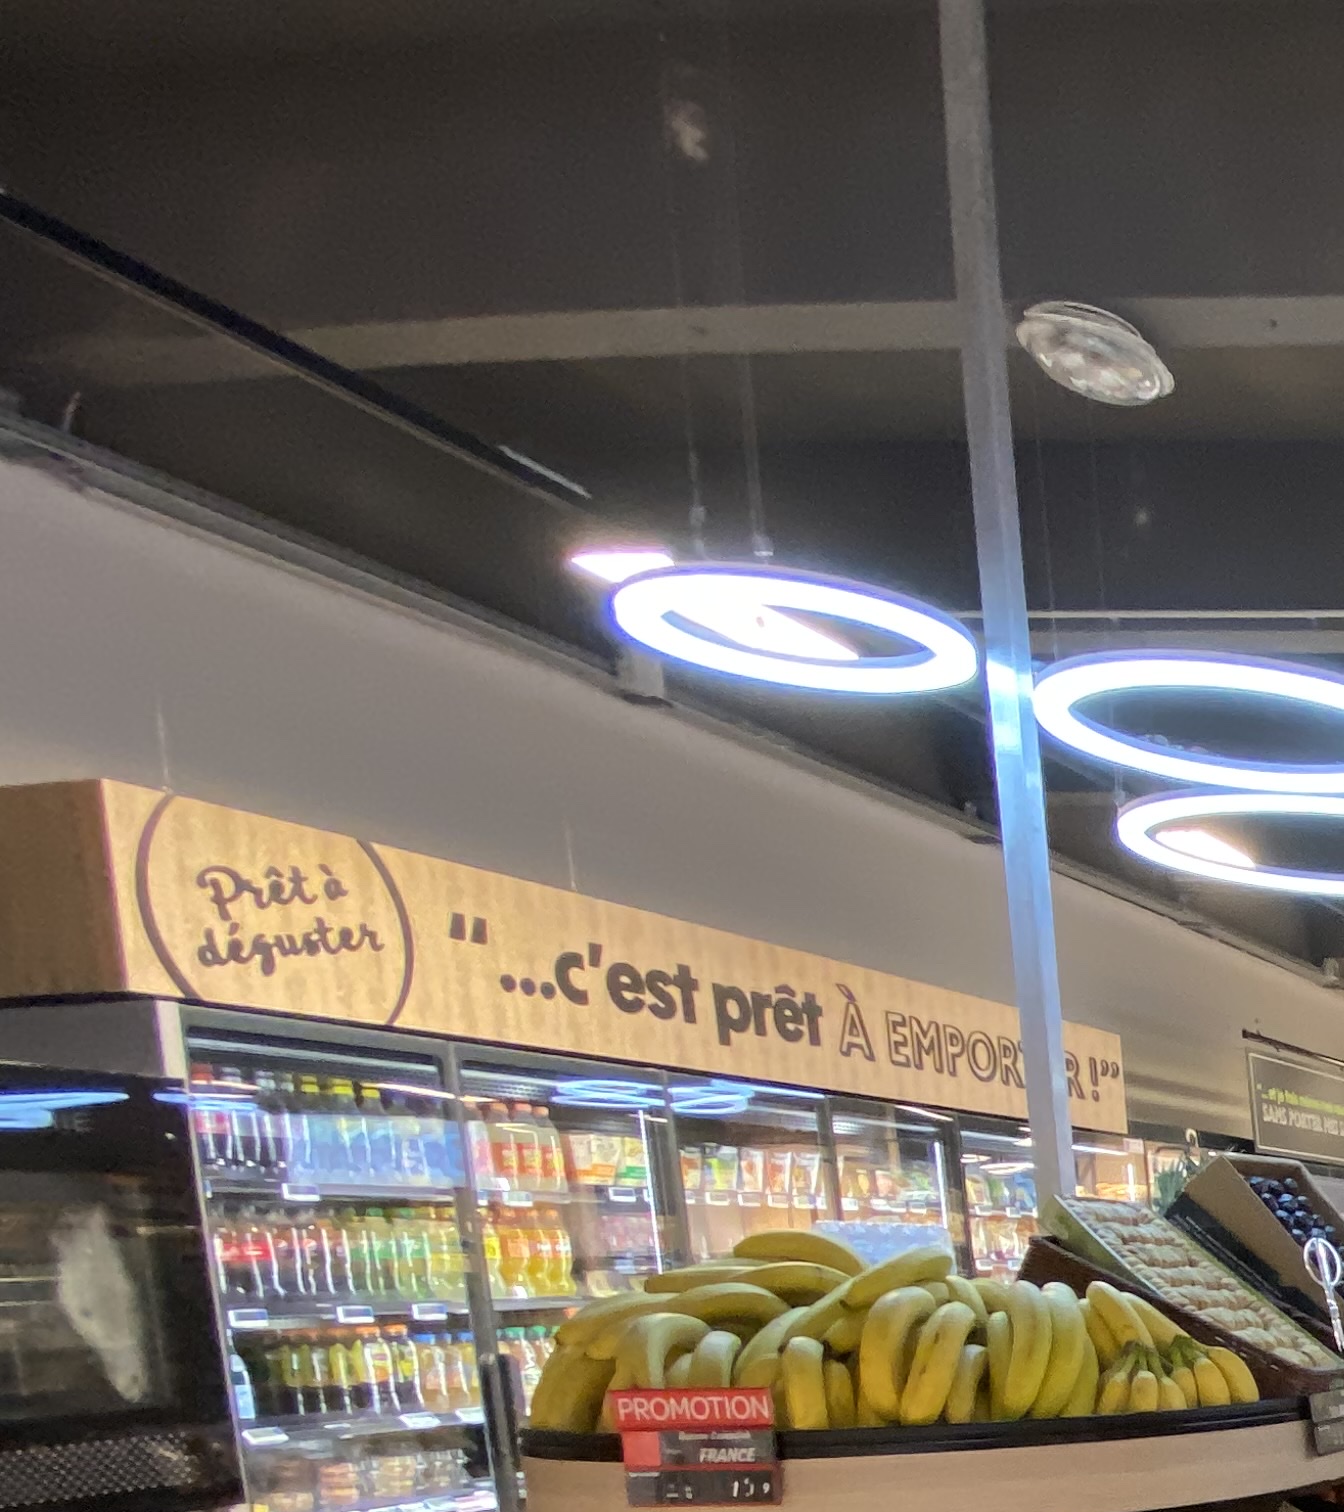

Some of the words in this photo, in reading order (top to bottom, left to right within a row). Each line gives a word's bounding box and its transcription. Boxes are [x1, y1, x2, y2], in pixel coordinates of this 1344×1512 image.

[196, 864, 318, 921] Prêt
[197, 916, 386, 977] déguster
[711, 982, 822, 1047] prêt
[887, 1012, 1087, 1101] EMPORR
[617, 1395, 770, 1422] PROMOTION
[699, 1447, 756, 1463] FRANCE
